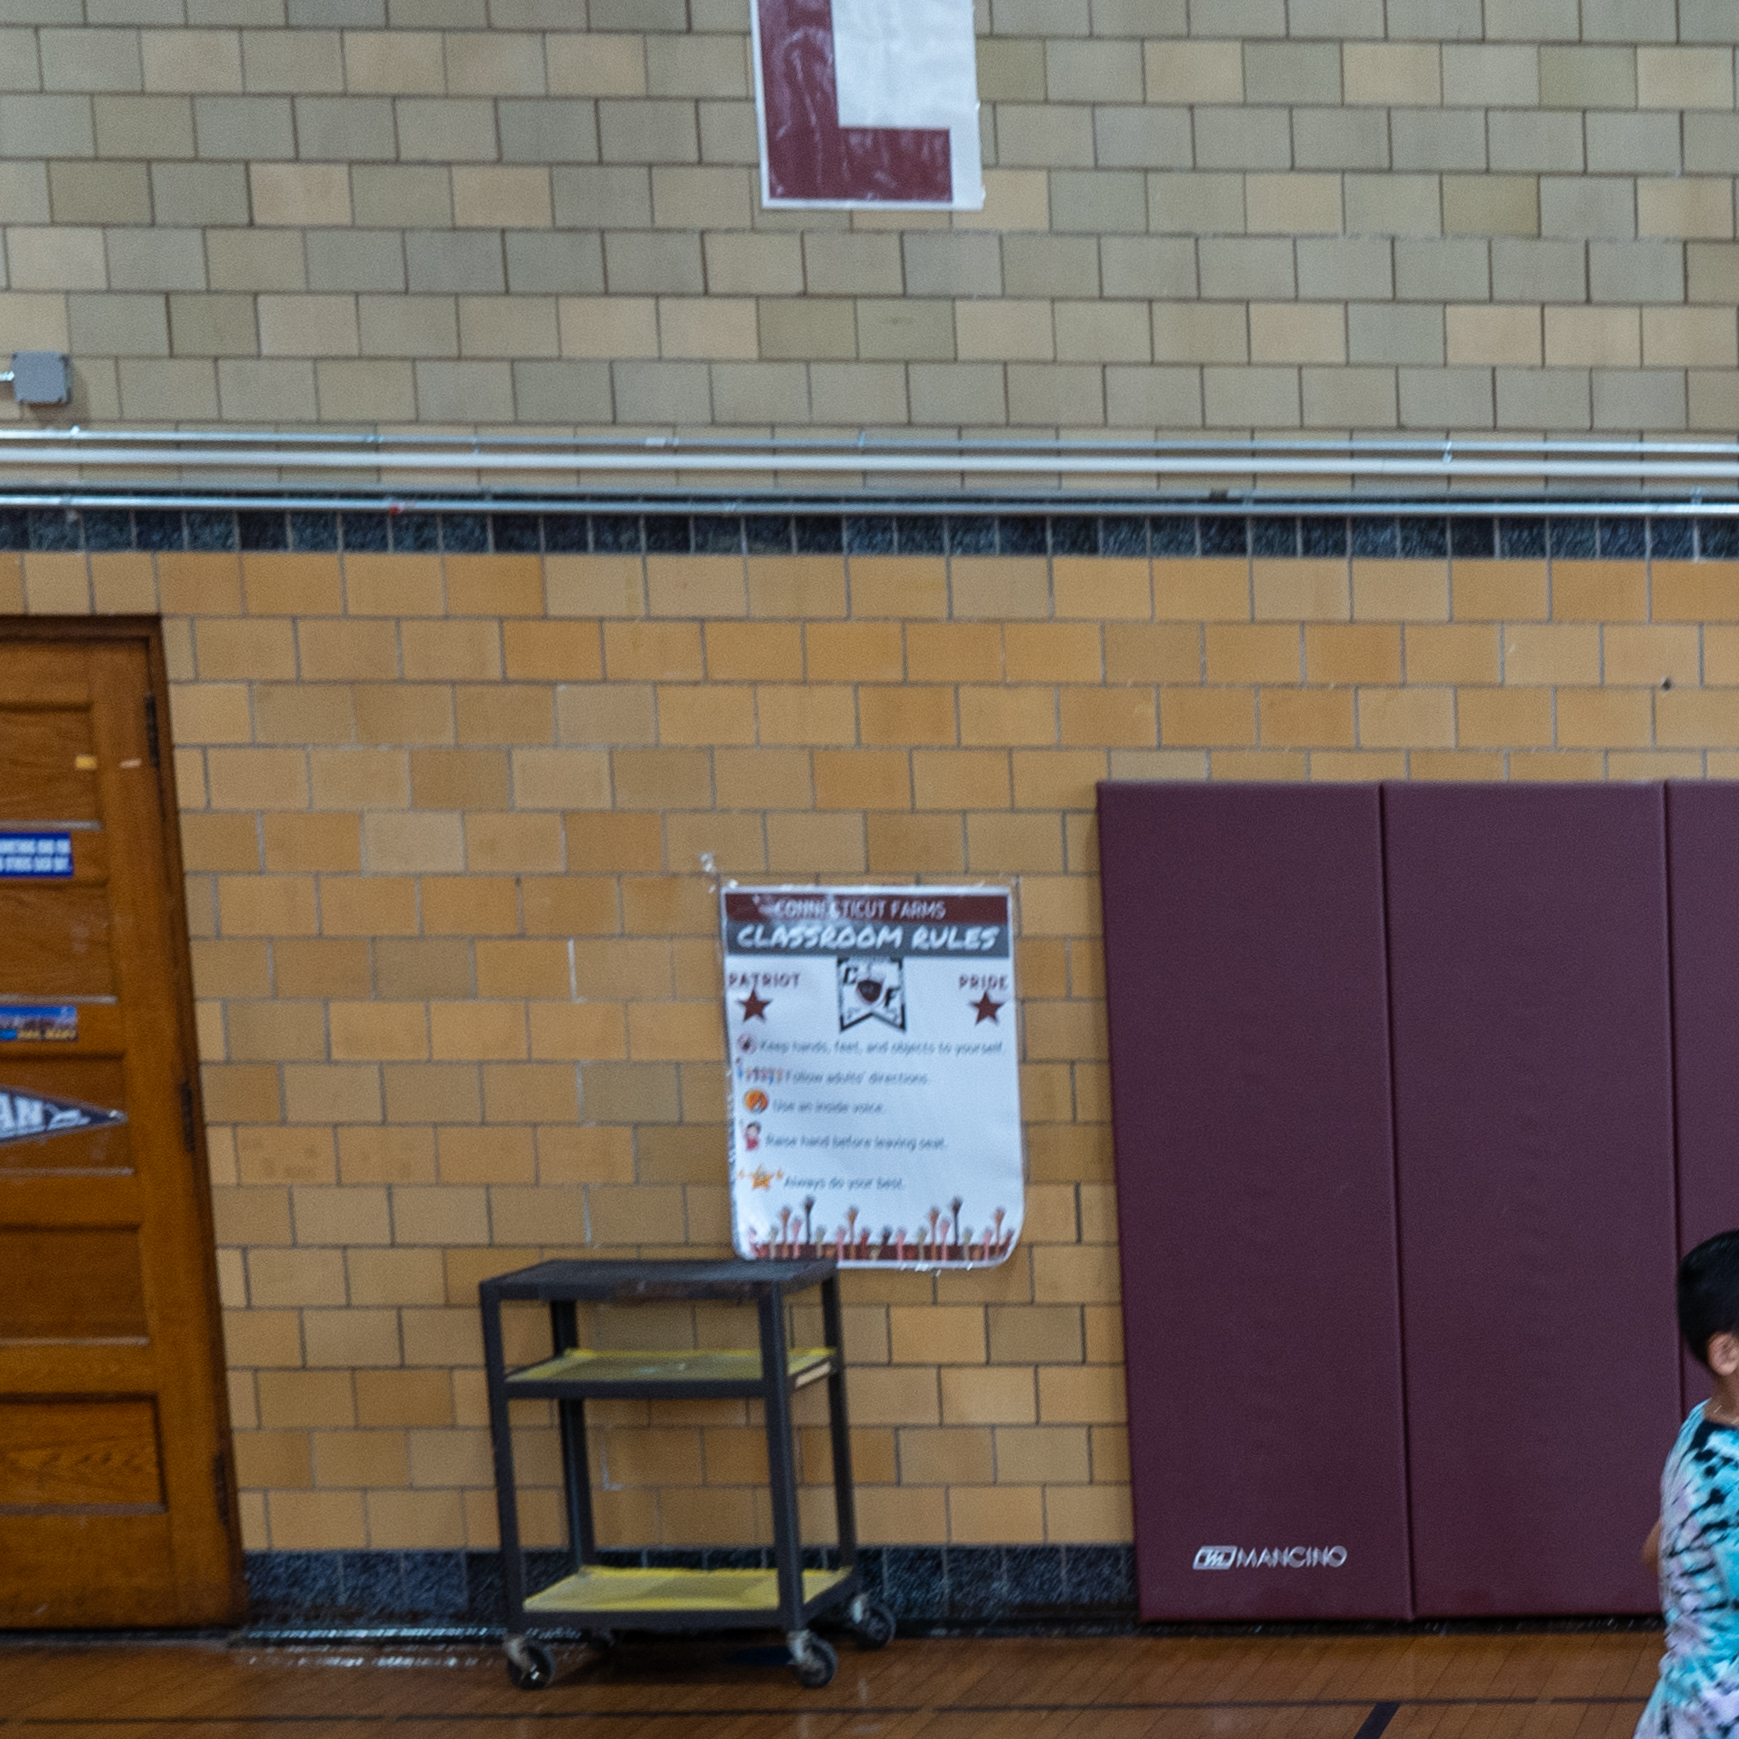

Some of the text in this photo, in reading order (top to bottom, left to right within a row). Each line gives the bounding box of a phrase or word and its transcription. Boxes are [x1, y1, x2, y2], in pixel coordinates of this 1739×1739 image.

[737, 923, 1000, 951] CLASSROOM RULES
[729, 973, 1008, 990] PATRIOT PRIDE
[1236, 1546, 1347, 1568] MANCINO
